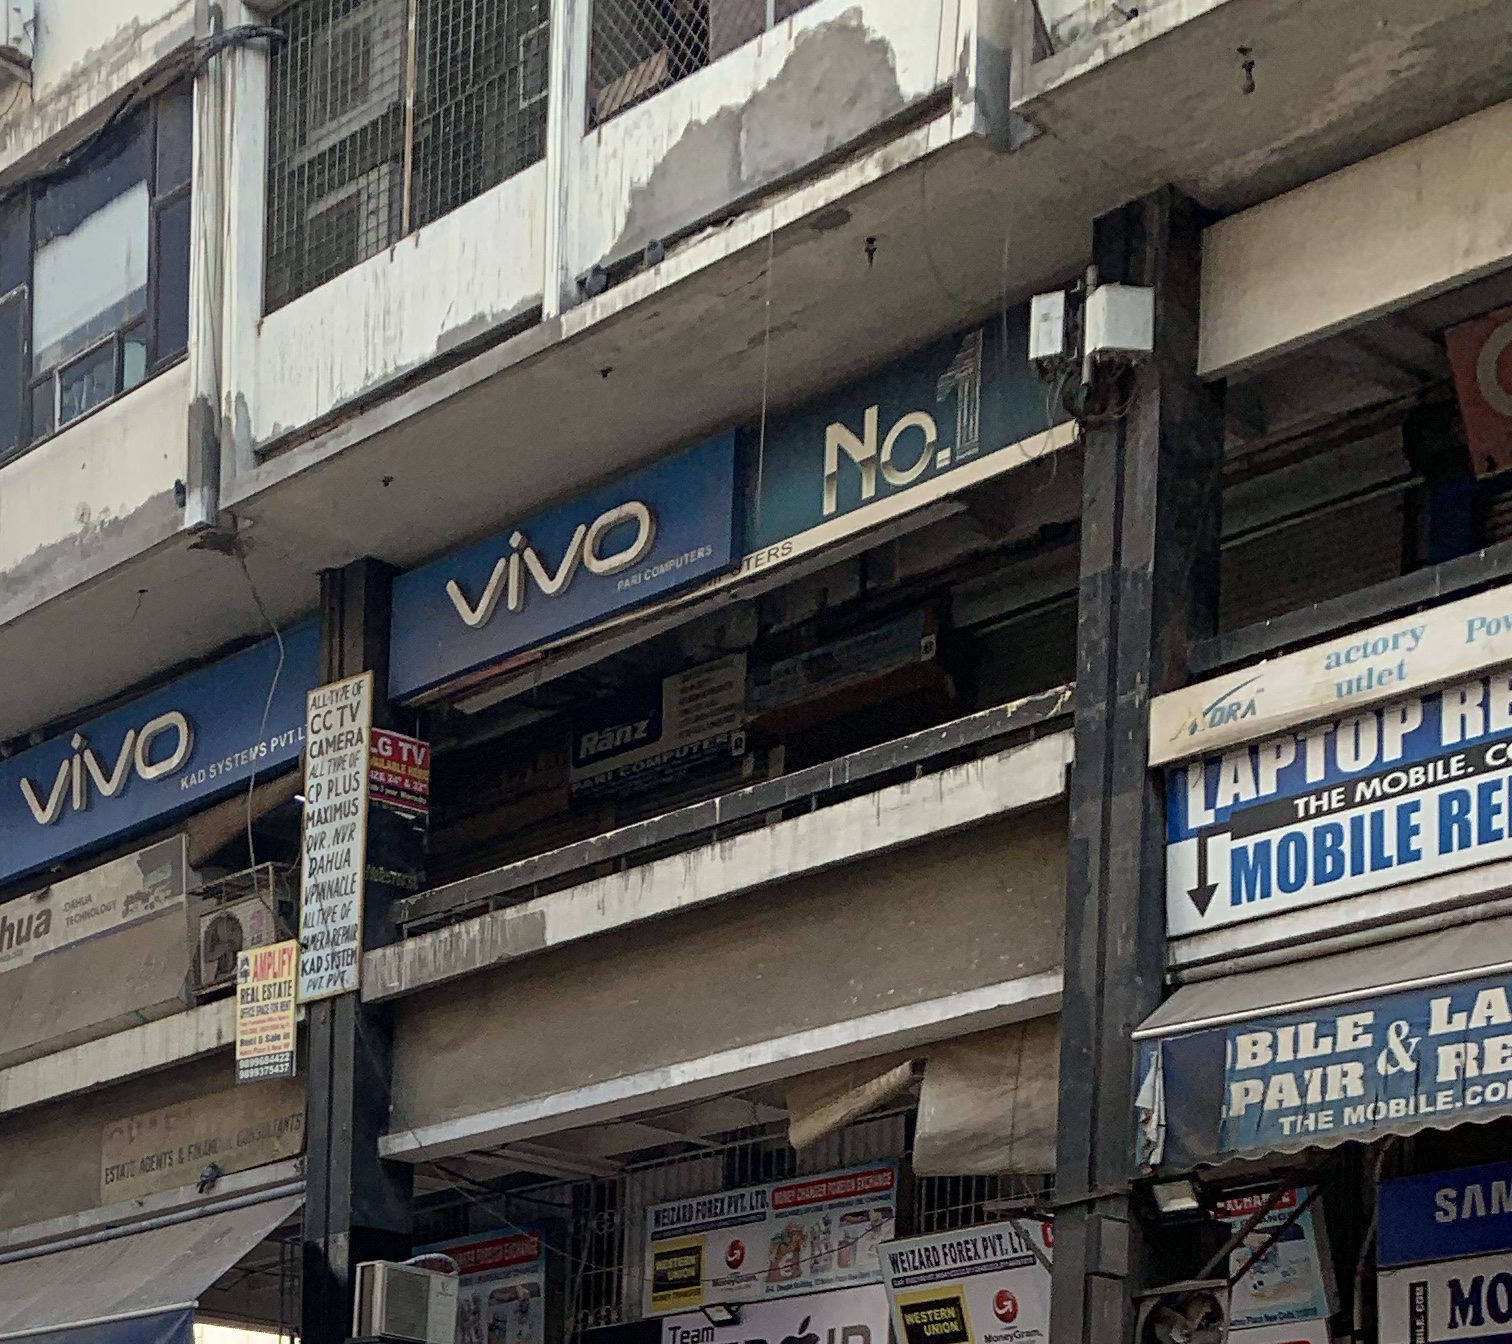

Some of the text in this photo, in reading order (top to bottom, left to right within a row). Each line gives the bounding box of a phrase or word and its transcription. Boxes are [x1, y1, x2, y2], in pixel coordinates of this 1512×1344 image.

[446, 501, 655, 626] vivo
[617, 545, 713, 592] PARI COMPUTERS
[310, 726, 364, 759] CAMERA
[399, 741, 426, 766] TV
[20, 710, 194, 825] vivo
[180, 742, 267, 791] KAD SYSTEMS
[1188, 699, 1424, 830] LAPTOP
[308, 770, 360, 805] CP PLUS
[1294, 753, 1475, 819] THE MOBILE.
[306, 797, 359, 830] MAXIMUS
[308, 848, 351, 879] DAHUA
[1230, 799, 1423, 907] MOBILE
[252, 946, 294, 983] AMPLIFY
[301, 954, 323, 978] KAD
[240, 979, 293, 1006] REAL ESTATE
[1378, 1020, 1421, 1076] &
[1279, 1108, 1334, 1135] THE
[695, 1196, 725, 1223] FOREX
[889, 1245, 941, 1274] WEIZARD
[942, 1237, 981, 1265] FOREX
[905, 1306, 956, 1325] WESTERN
[923, 1320, 959, 1337] UNION
